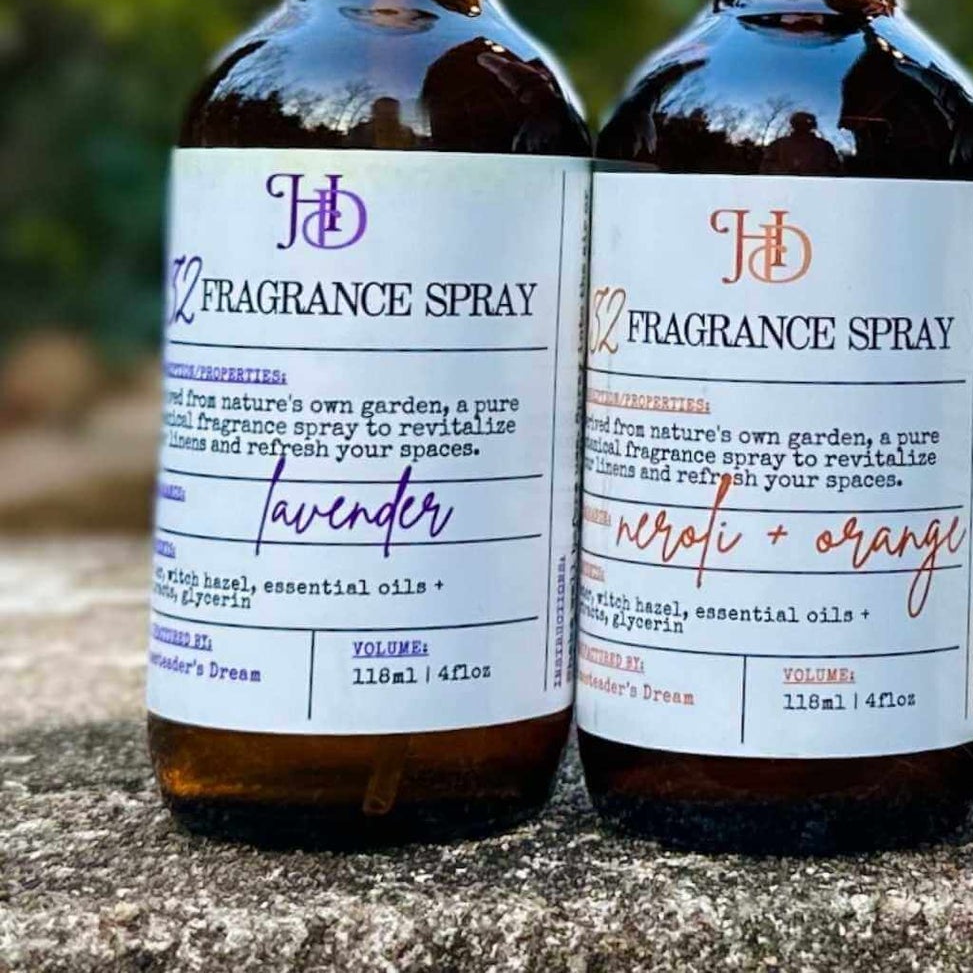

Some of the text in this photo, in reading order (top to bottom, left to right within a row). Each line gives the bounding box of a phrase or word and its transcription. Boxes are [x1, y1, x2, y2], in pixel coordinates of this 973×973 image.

[201, 278, 412, 318] FRAGRANCE
[425, 281, 538, 318] SPRAY
[626, 309, 836, 350] FRAGRANCE
[848, 315, 955, 351] SPRAY
[186, 389, 520, 419] from nature's own garden, a pure
[197, 411, 287, 436] fragrance
[293, 418, 358, 440] spray
[366, 418, 392, 437] to
[397, 415, 517, 437] revitalize
[613, 416, 941, 451] from nature's own garden, a pure
[168, 429, 481, 463] linens and refresh your spaces.
[625, 440, 717, 465] fragrance
[722, 449, 787, 471] spray
[792, 449, 818, 468] to
[824, 447, 938, 468] revitalize
[595, 455, 636, 478] linens
[639, 464, 671, 482] and
[676, 467, 758, 487] refrsh
[763, 473, 819, 492] your
[825, 473, 903, 493] spaces.
[255, 457, 454, 557] lavender
[616, 473, 967, 619] neroli + orange
[203, 571, 257, 595] hazel,
[263, 578, 370, 596] essential
[378, 578, 427, 596] oils
[434, 579, 444, 591] +
[181, 588, 252, 610] glycerin
[634, 596, 689, 620] hazel,
[695, 606, 800, 623] essential
[806, 606, 854, 624] oils
[860, 609, 871, 620] +
[612, 610, 684, 634] glycerin
[352, 639, 430, 659] VOLUME:
[209, 660, 262, 683] Dream
[352, 662, 492, 686] 118ml 4floz
[782, 667, 856, 685] VOLUME:
[642, 683, 696, 706] Dream
[782, 691, 917, 711] 118ml 4floz
